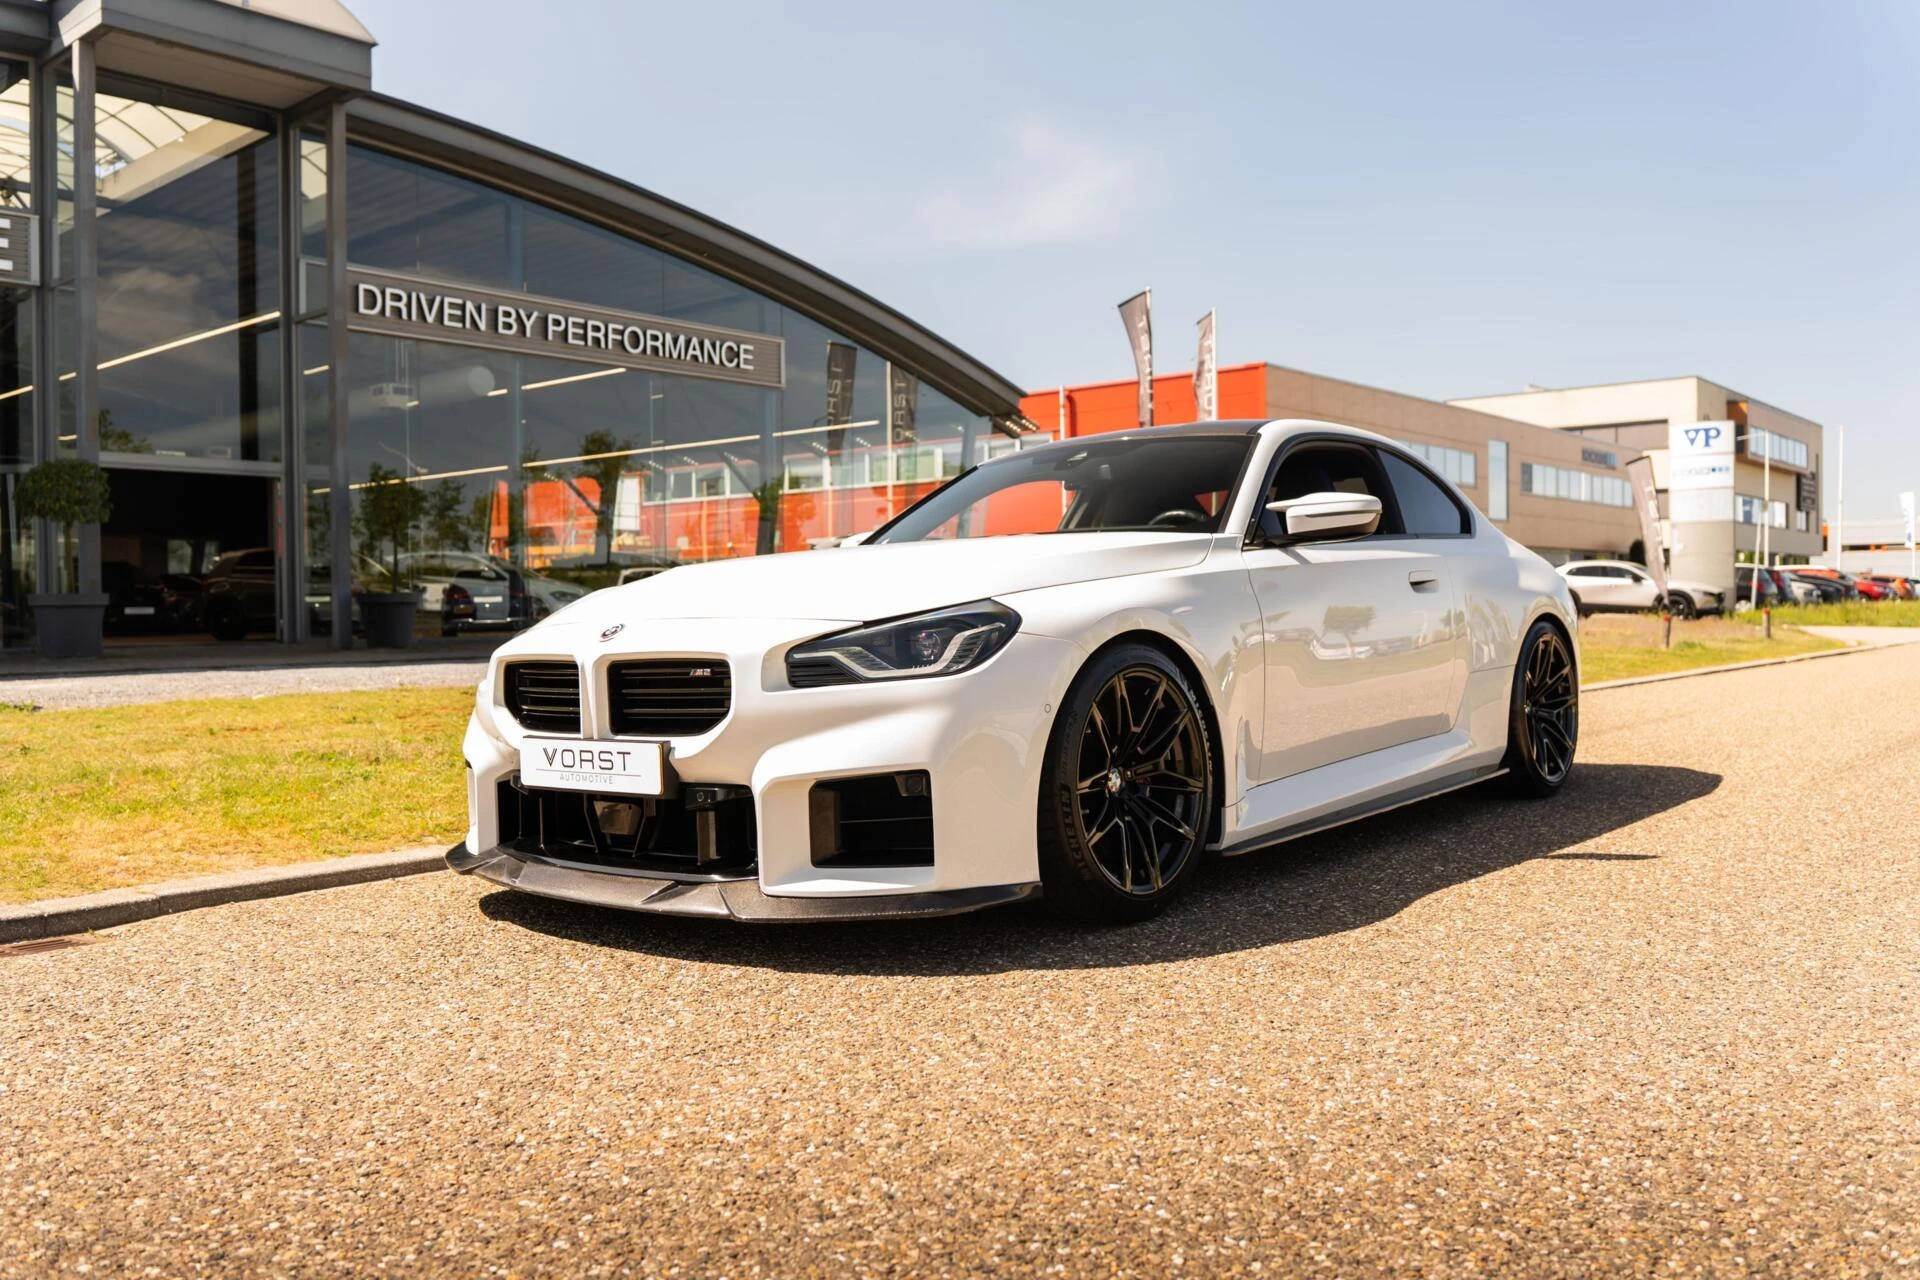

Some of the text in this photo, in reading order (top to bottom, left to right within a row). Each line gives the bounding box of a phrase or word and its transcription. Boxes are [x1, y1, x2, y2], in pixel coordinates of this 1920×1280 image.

[357, 283, 755, 371] DRIVEN BY PERFORMANCE
[1683, 427, 1721, 448] VP
[542, 747, 632, 772] VORST
[559, 773, 614, 785] AUTOMOTIVE
